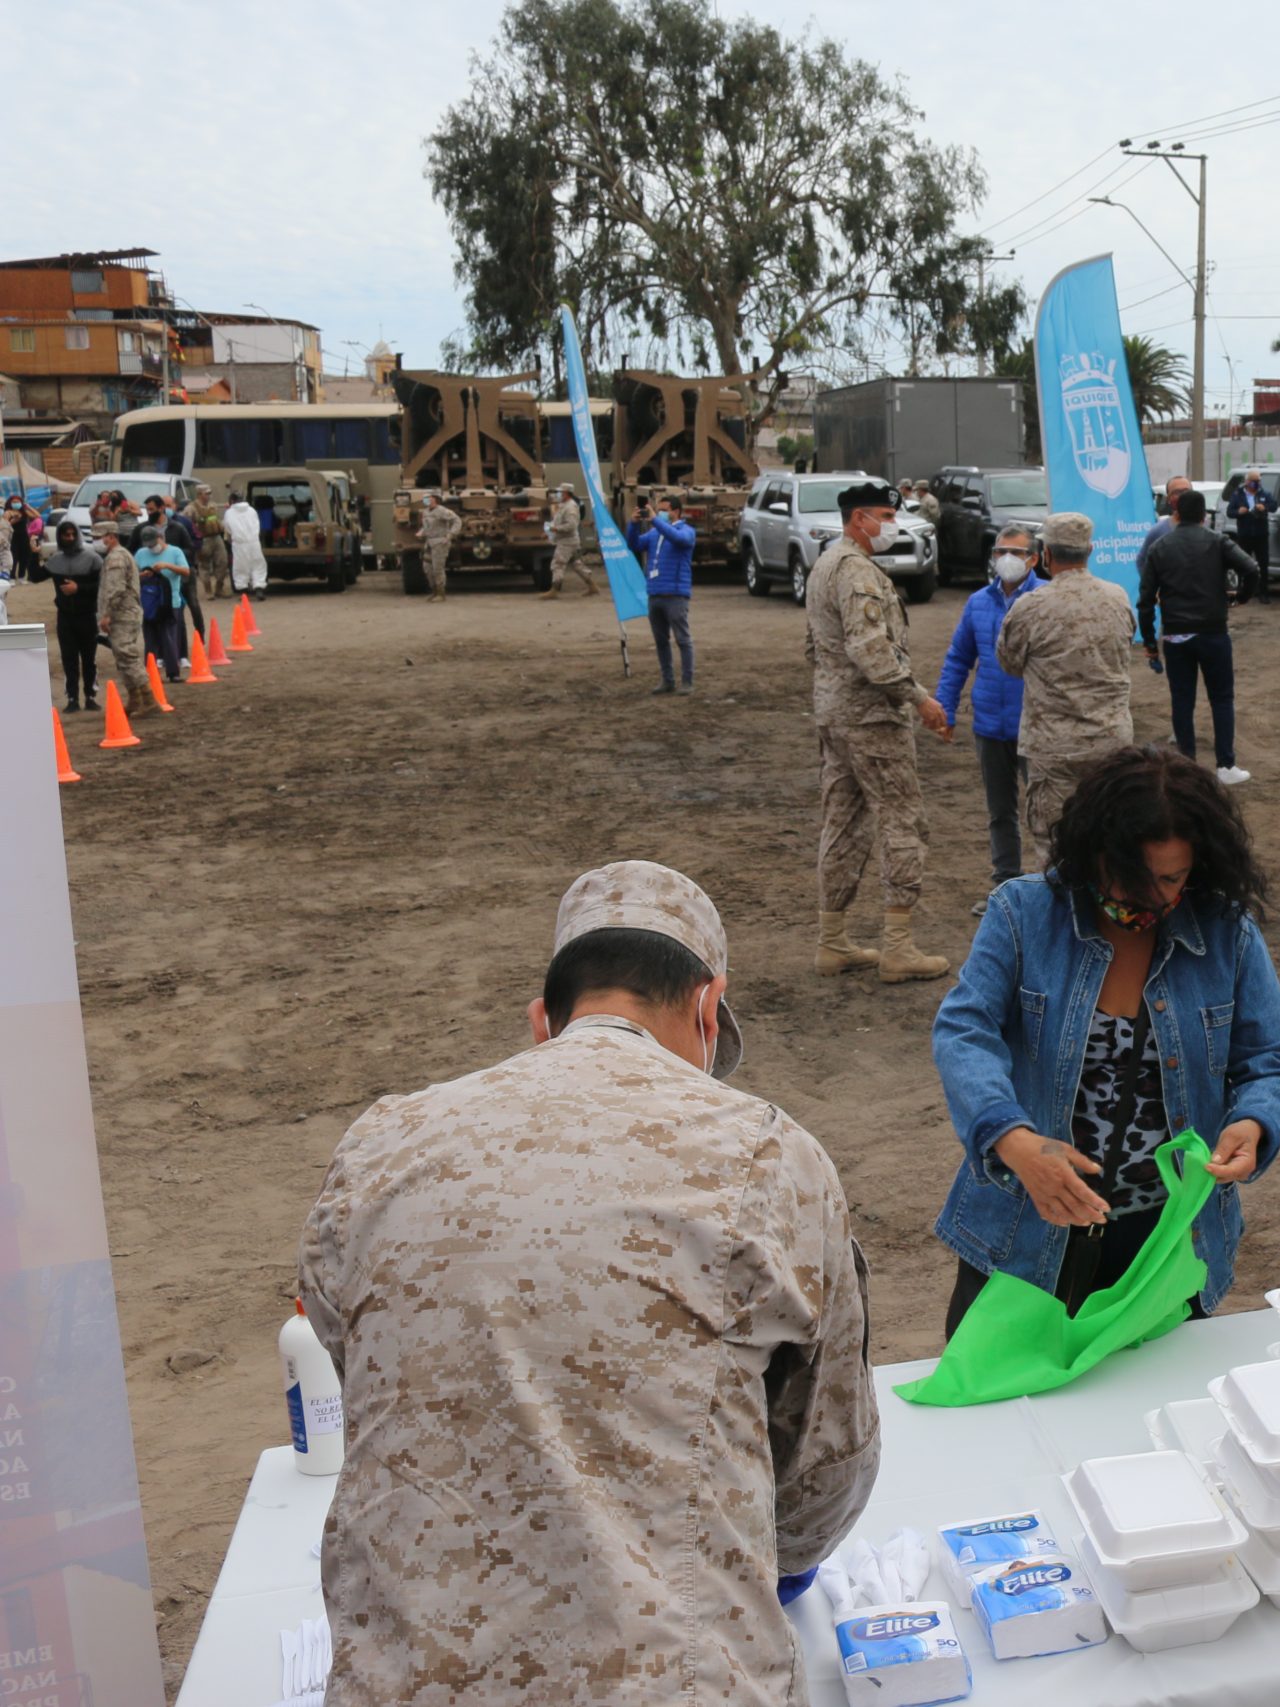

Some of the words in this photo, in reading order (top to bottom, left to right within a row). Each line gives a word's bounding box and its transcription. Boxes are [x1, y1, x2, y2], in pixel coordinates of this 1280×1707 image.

[1117, 520, 1151, 533] Ilustre
[1093, 533, 1145, 550] nicipalida
[1096, 551, 1112, 564] de
[1115, 549, 1137, 565] Iqui
[972, 1519, 1031, 1535] Elite
[1037, 1538, 1056, 1546] 50
[1003, 1567, 1062, 1594] Elite
[866, 1617, 932, 1637] Elite
